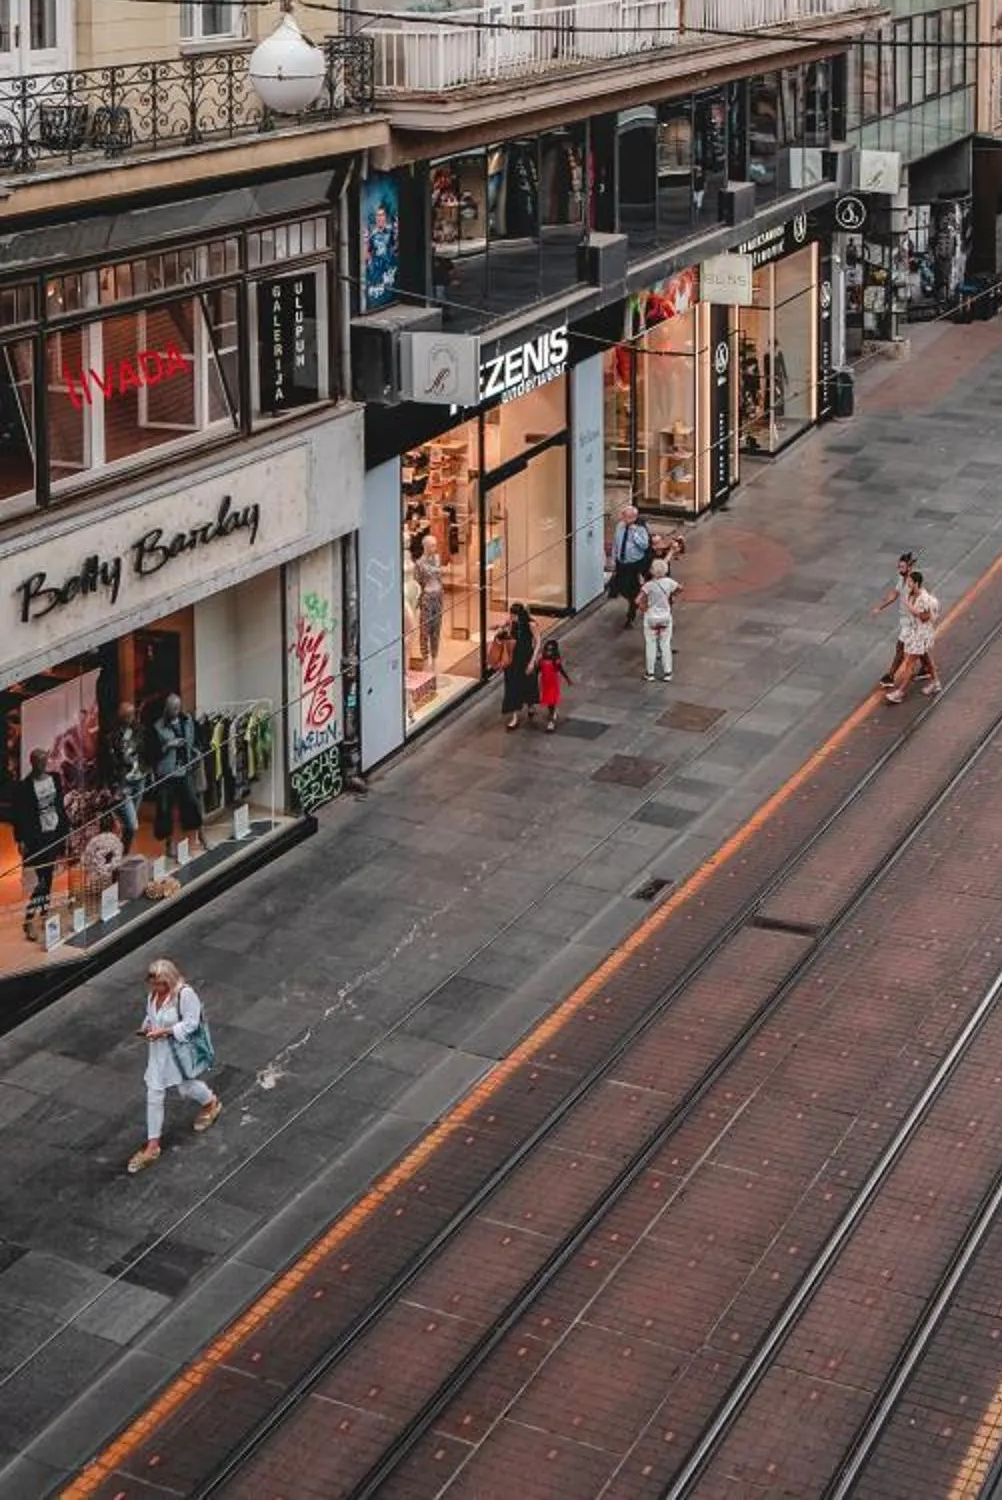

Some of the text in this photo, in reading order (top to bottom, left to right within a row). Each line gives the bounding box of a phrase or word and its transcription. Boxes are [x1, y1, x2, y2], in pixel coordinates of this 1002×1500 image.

[271, 285, 284, 401] GALERIJA
[450, 325, 569, 415] ZENIS
[16, 494, 261, 623] Betty Barclay
